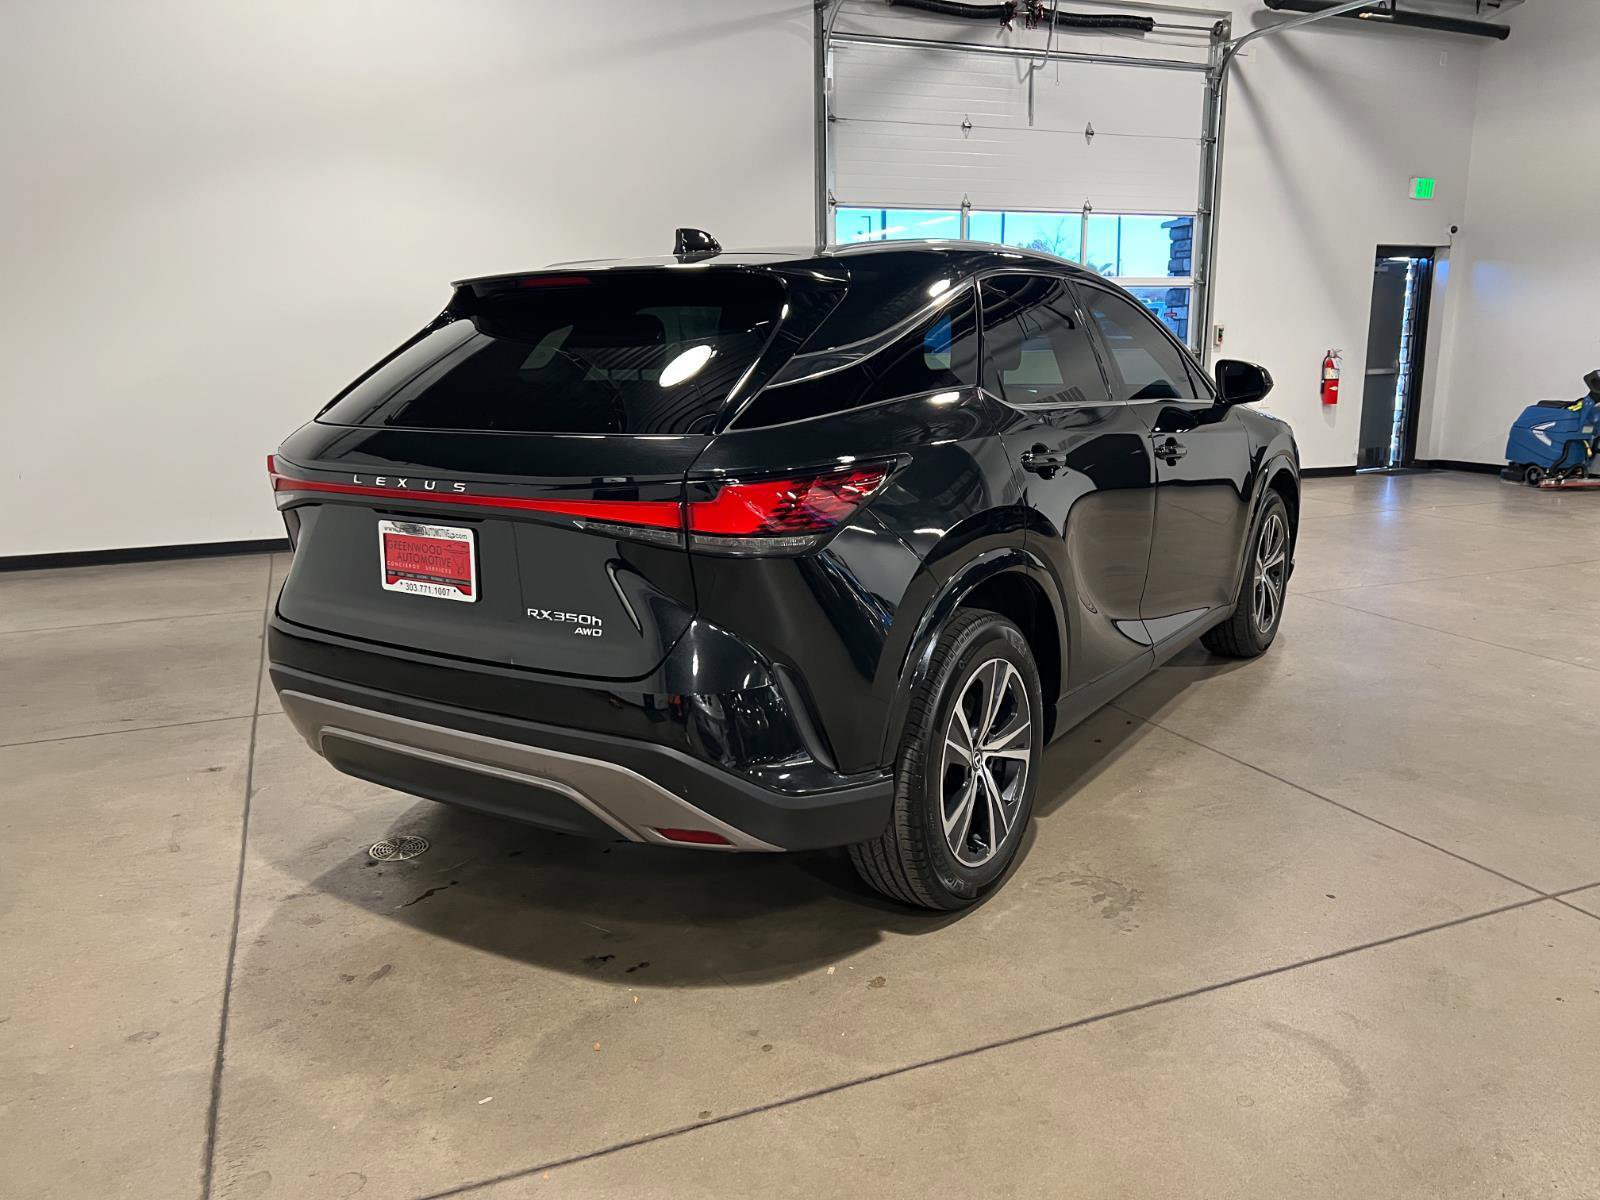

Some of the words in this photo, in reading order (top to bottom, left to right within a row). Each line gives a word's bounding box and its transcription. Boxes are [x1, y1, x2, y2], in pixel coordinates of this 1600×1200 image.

[353, 474, 467, 493] LEXUS
[388, 540, 442, 556] GREENWOOD
[398, 552, 452, 568] AUTOMOTIVE
[527, 608, 602, 627] RX350h
[574, 627, 602, 637] AWD
